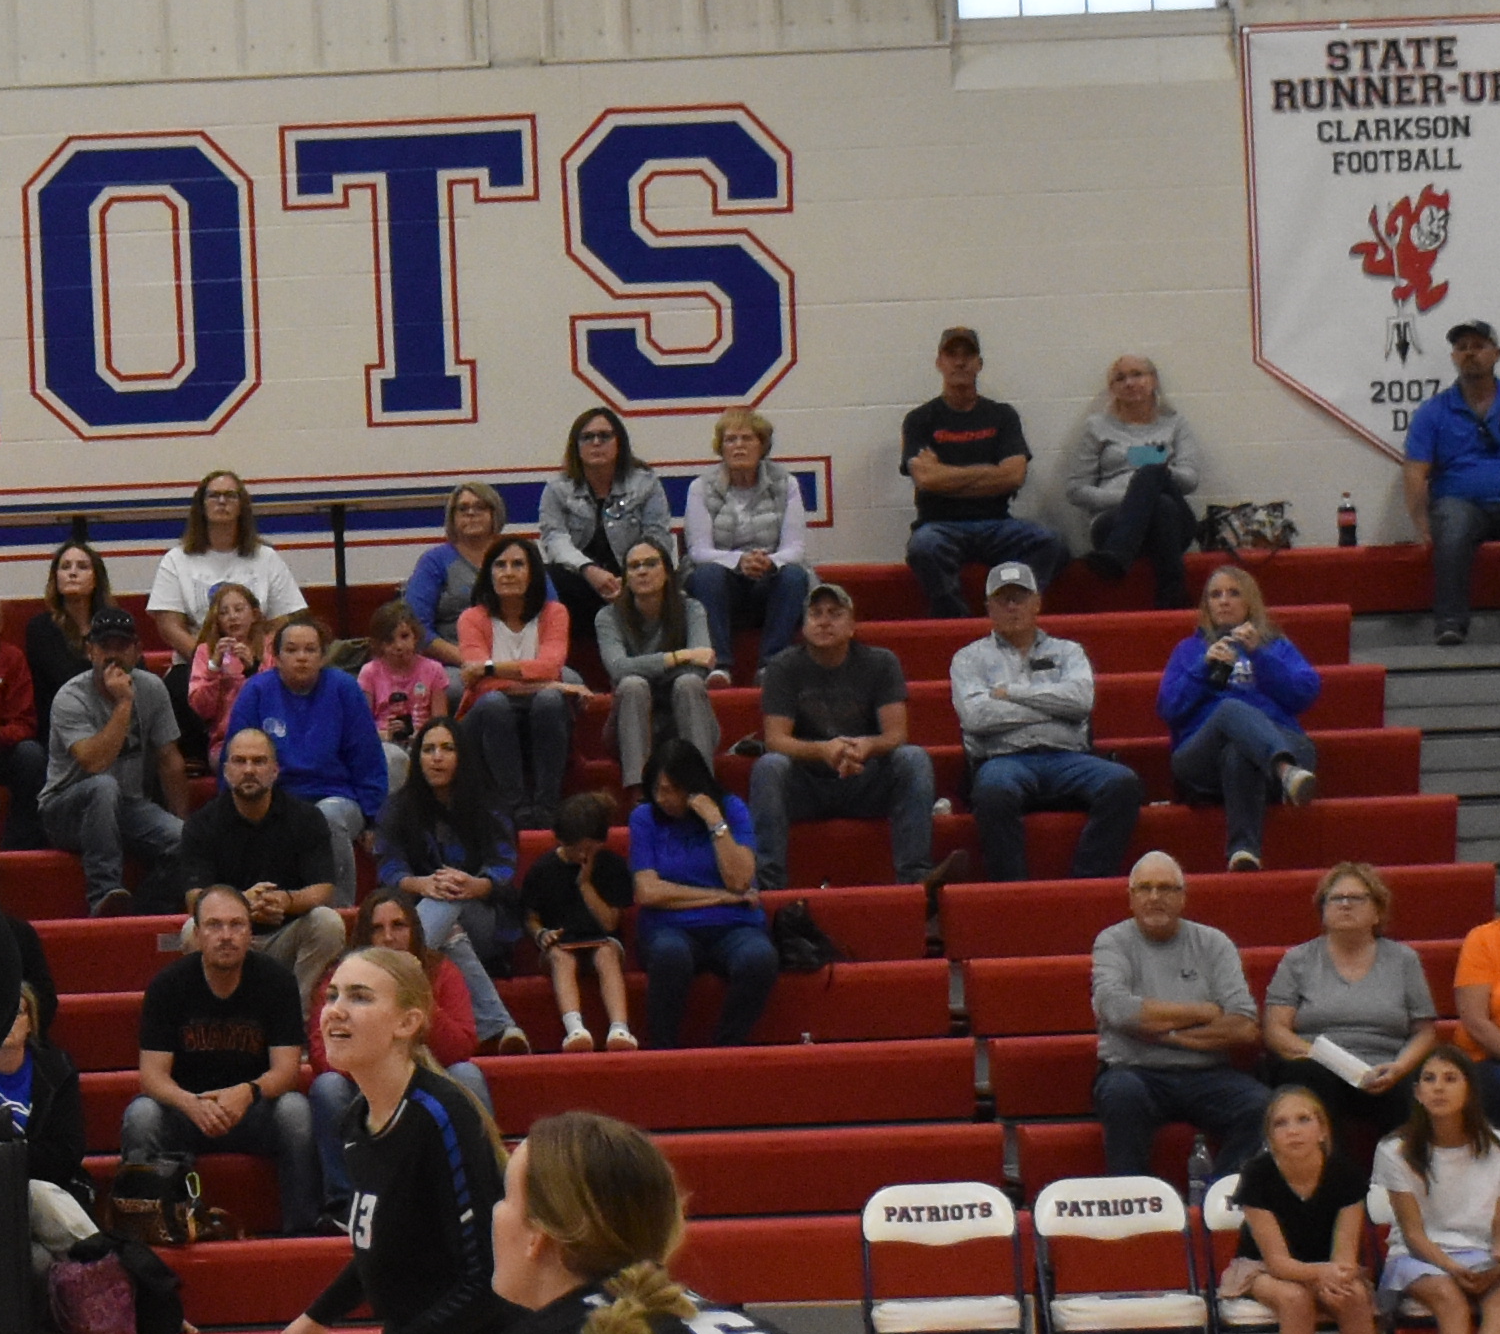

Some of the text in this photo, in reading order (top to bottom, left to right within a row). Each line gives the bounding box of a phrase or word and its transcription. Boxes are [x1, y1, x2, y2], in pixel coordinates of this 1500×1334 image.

[1326, 35, 1458, 72] STATE
[1316, 115, 1471, 144] CLARKSON
[1332, 147, 1462, 175] FOOTBALL
[1370, 378, 1440, 404] 2007
[884, 1202, 993, 1224] PATRIOTS
[1054, 1196, 1163, 1218] PATRIOTS
